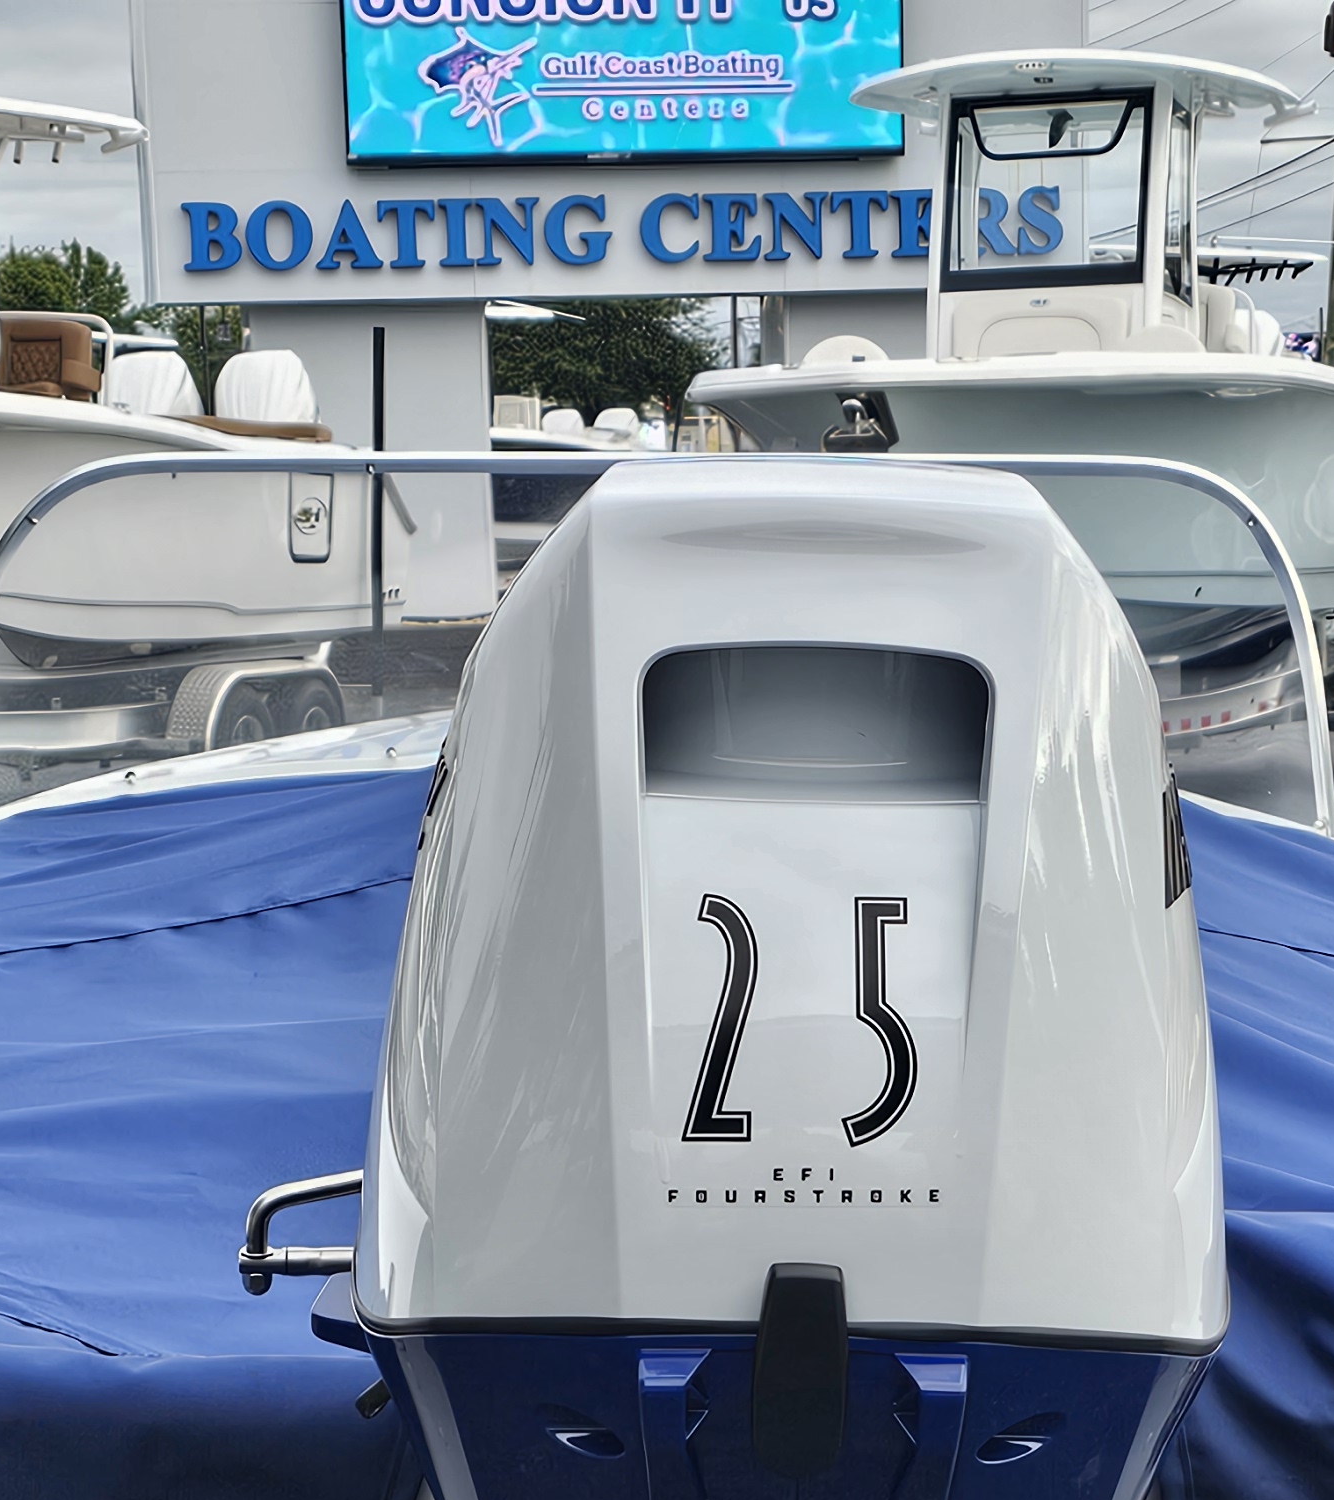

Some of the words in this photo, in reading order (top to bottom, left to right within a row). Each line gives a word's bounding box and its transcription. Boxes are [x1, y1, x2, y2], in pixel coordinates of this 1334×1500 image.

[543, 55, 598, 76] Gulf
[603, 56, 677, 76] Coast
[683, 54, 780, 78] Boating
[584, 99, 747, 118] Centers
[180, 193, 614, 273] BOATING
[680, 892, 919, 1148] 25
[772, 1167, 835, 1182] EFI
[667, 1188, 940, 1204] FOURSTROKE
